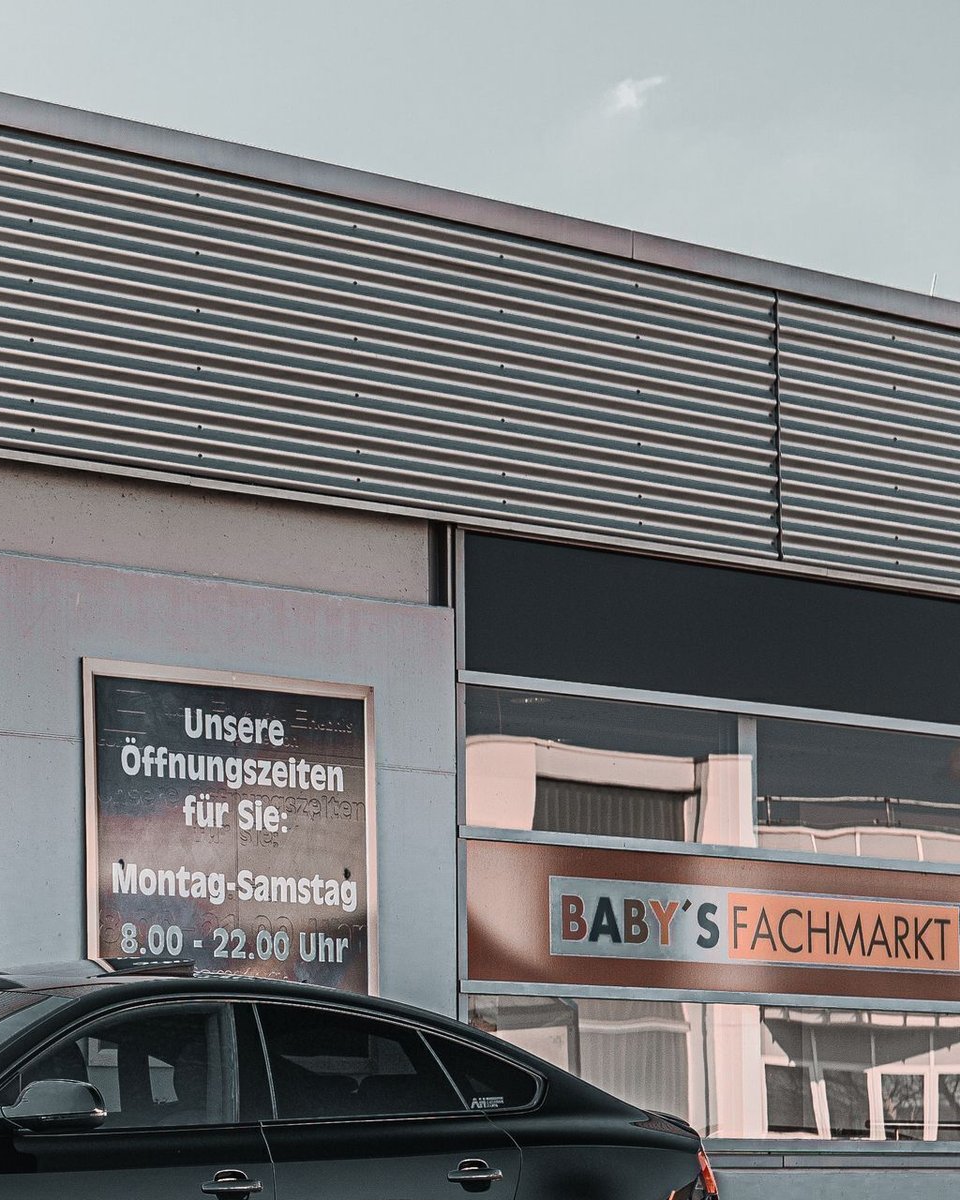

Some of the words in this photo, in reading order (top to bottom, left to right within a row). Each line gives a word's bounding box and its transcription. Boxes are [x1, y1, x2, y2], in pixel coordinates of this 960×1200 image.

[183, 707, 285, 747] Unsere
[120, 737, 345, 793] Öffnungszeiten
[182, 793, 230, 829] für
[237, 799, 289, 834] Sie:
[111, 862, 358, 913] Montag-Samstag
[120, 922, 184, 956] 8.00
[212, 927, 290, 962] 22.00
[298, 931, 350, 963] Uhr
[732, 905, 952, 961] FACHMARKT
